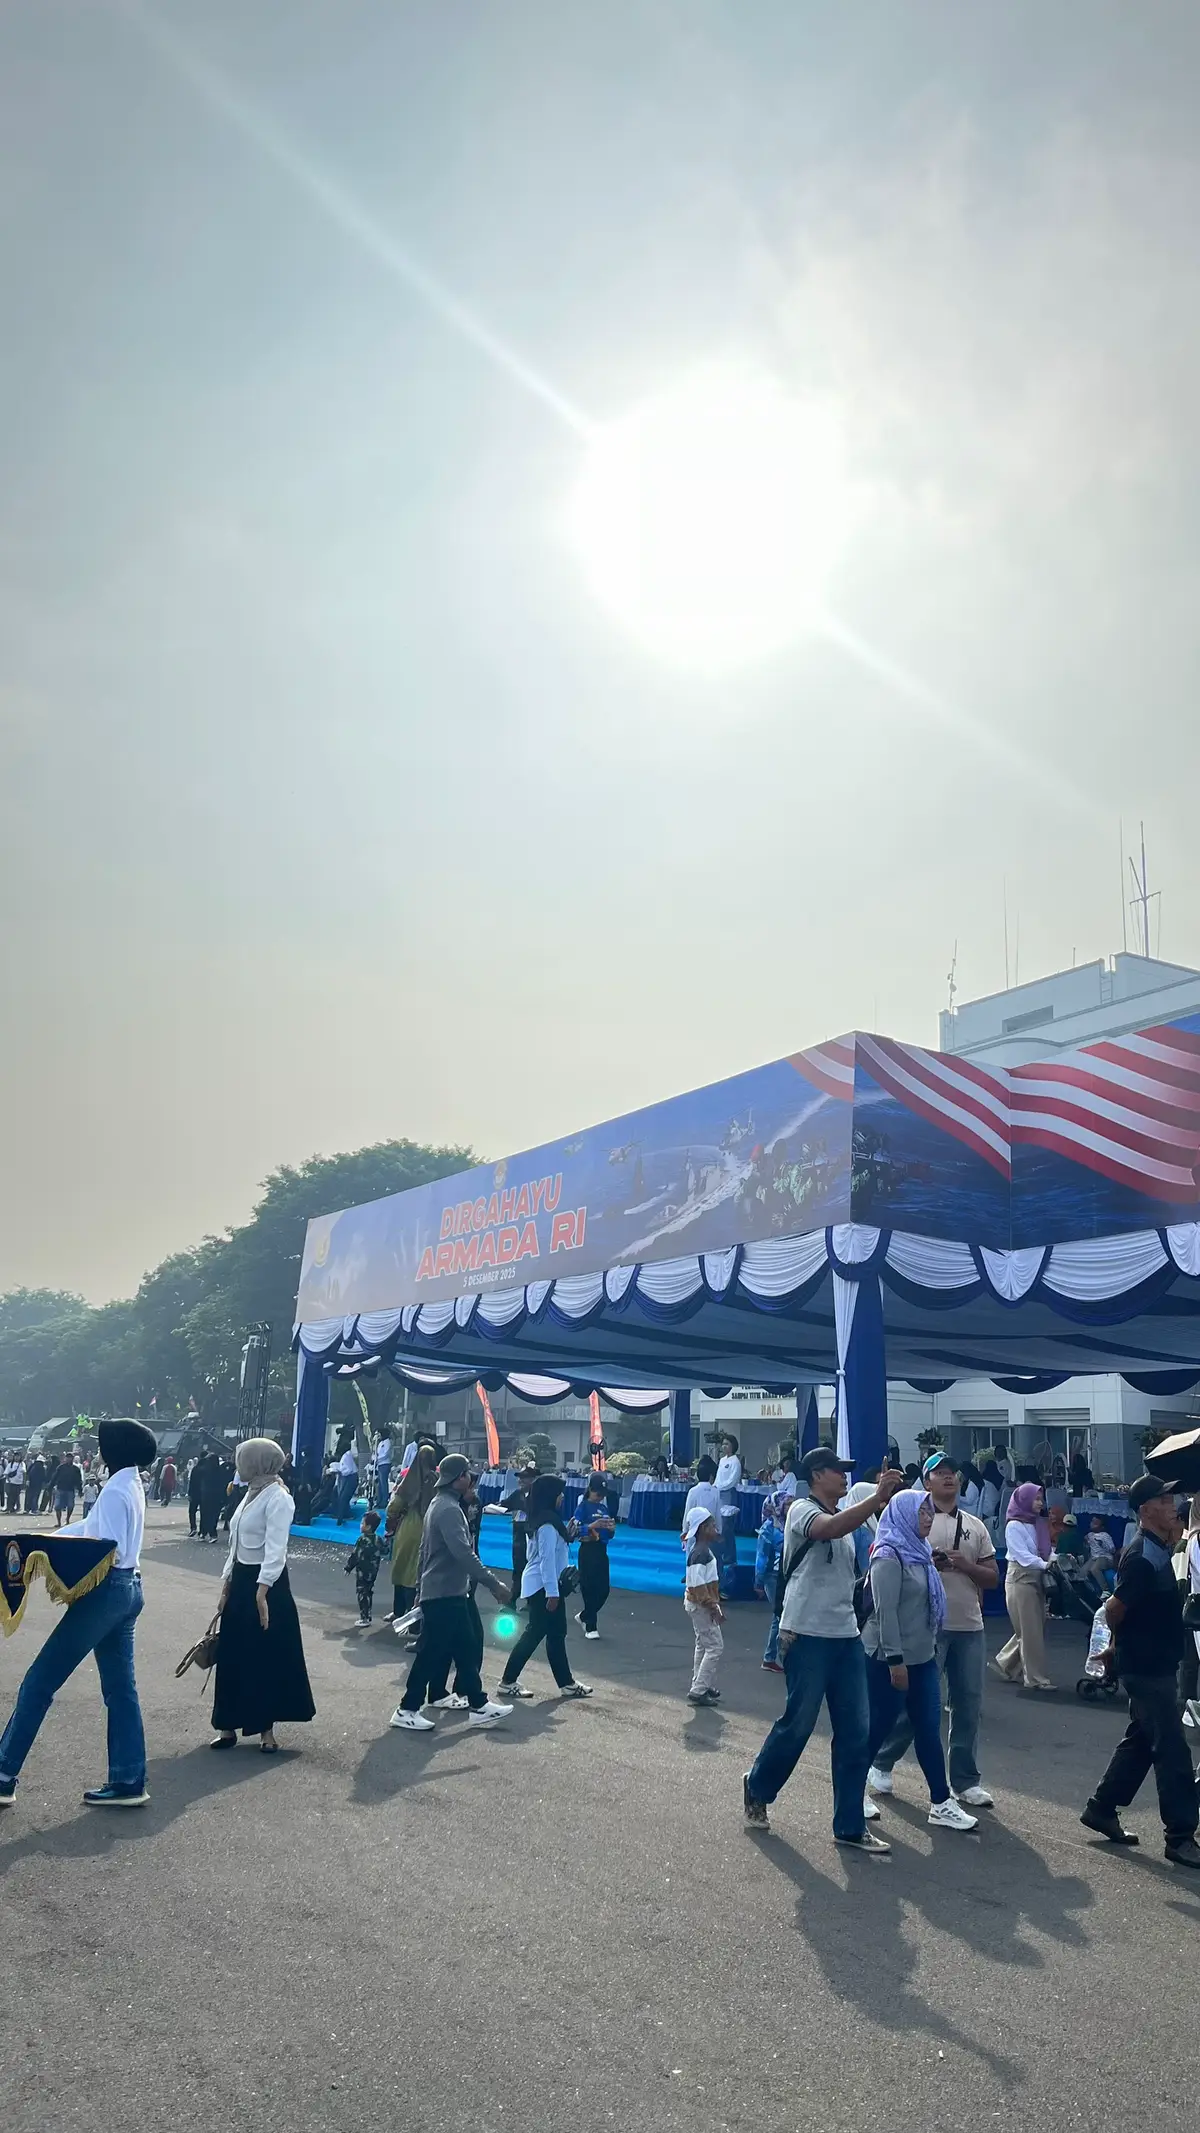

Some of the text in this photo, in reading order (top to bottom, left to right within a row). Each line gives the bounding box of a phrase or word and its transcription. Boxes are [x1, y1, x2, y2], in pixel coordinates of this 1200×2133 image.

[440, 1172, 563, 1240] DIRGAHAYU
[415, 1206, 587, 1282] ARMADA RI
[463, 1266, 516, 1288] 5 DESEMBER 2025
